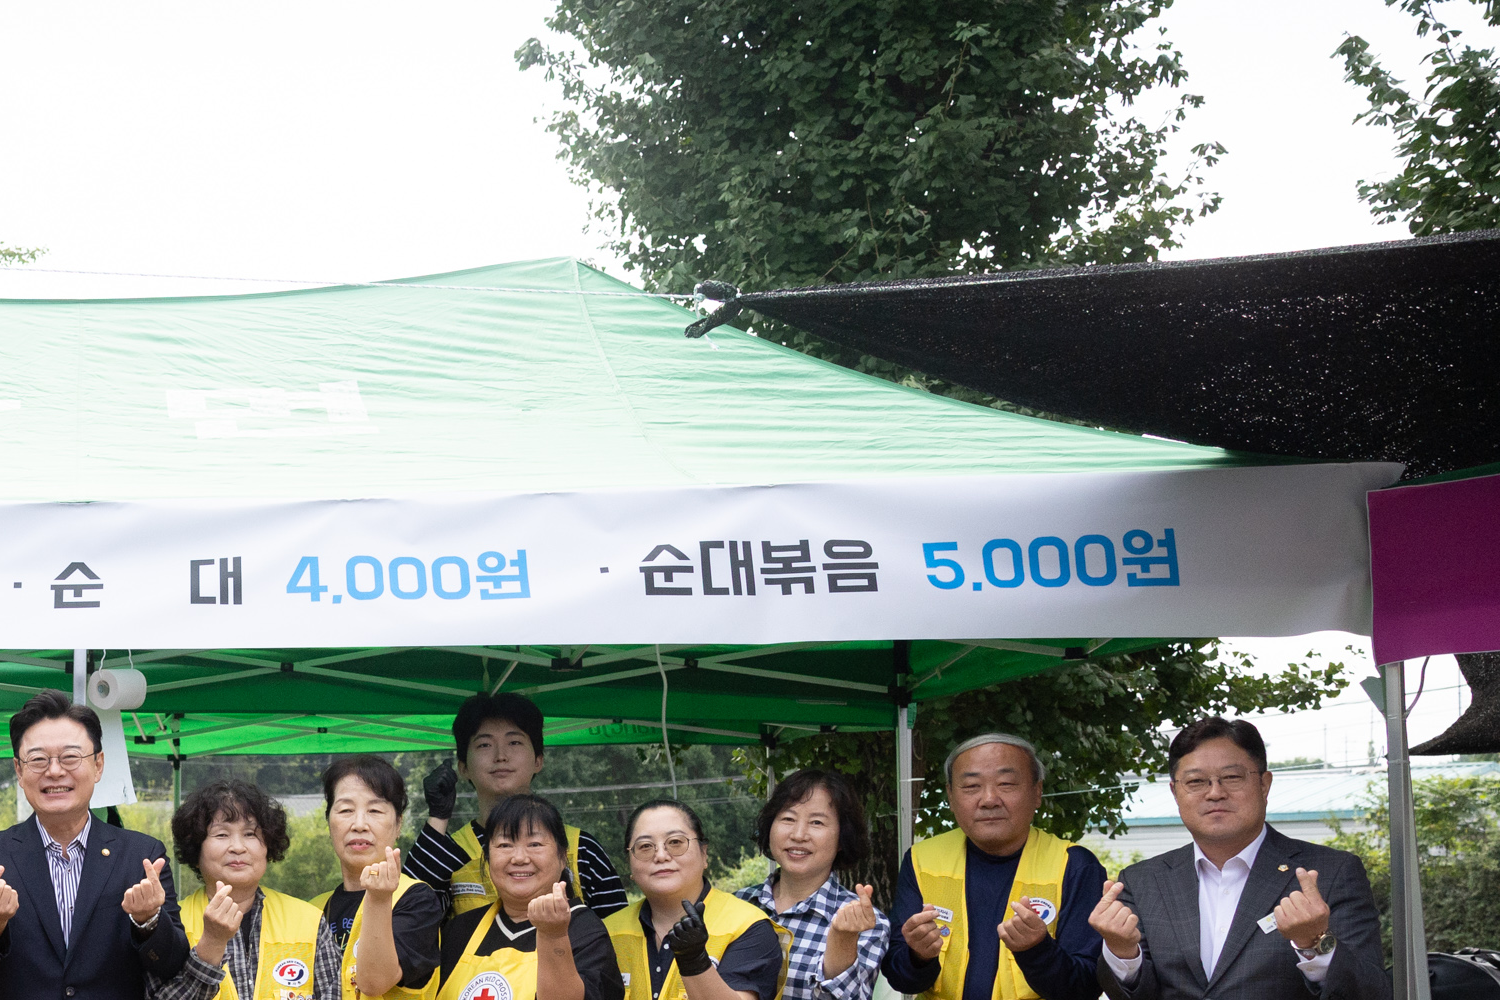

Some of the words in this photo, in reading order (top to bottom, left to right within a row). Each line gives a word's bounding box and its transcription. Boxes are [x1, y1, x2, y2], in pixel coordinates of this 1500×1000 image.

[639, 539, 879, 596] 순대볶음
[462, 977, 484, 1000] KOREAN
[495, 979, 508, 1000] CROSS
